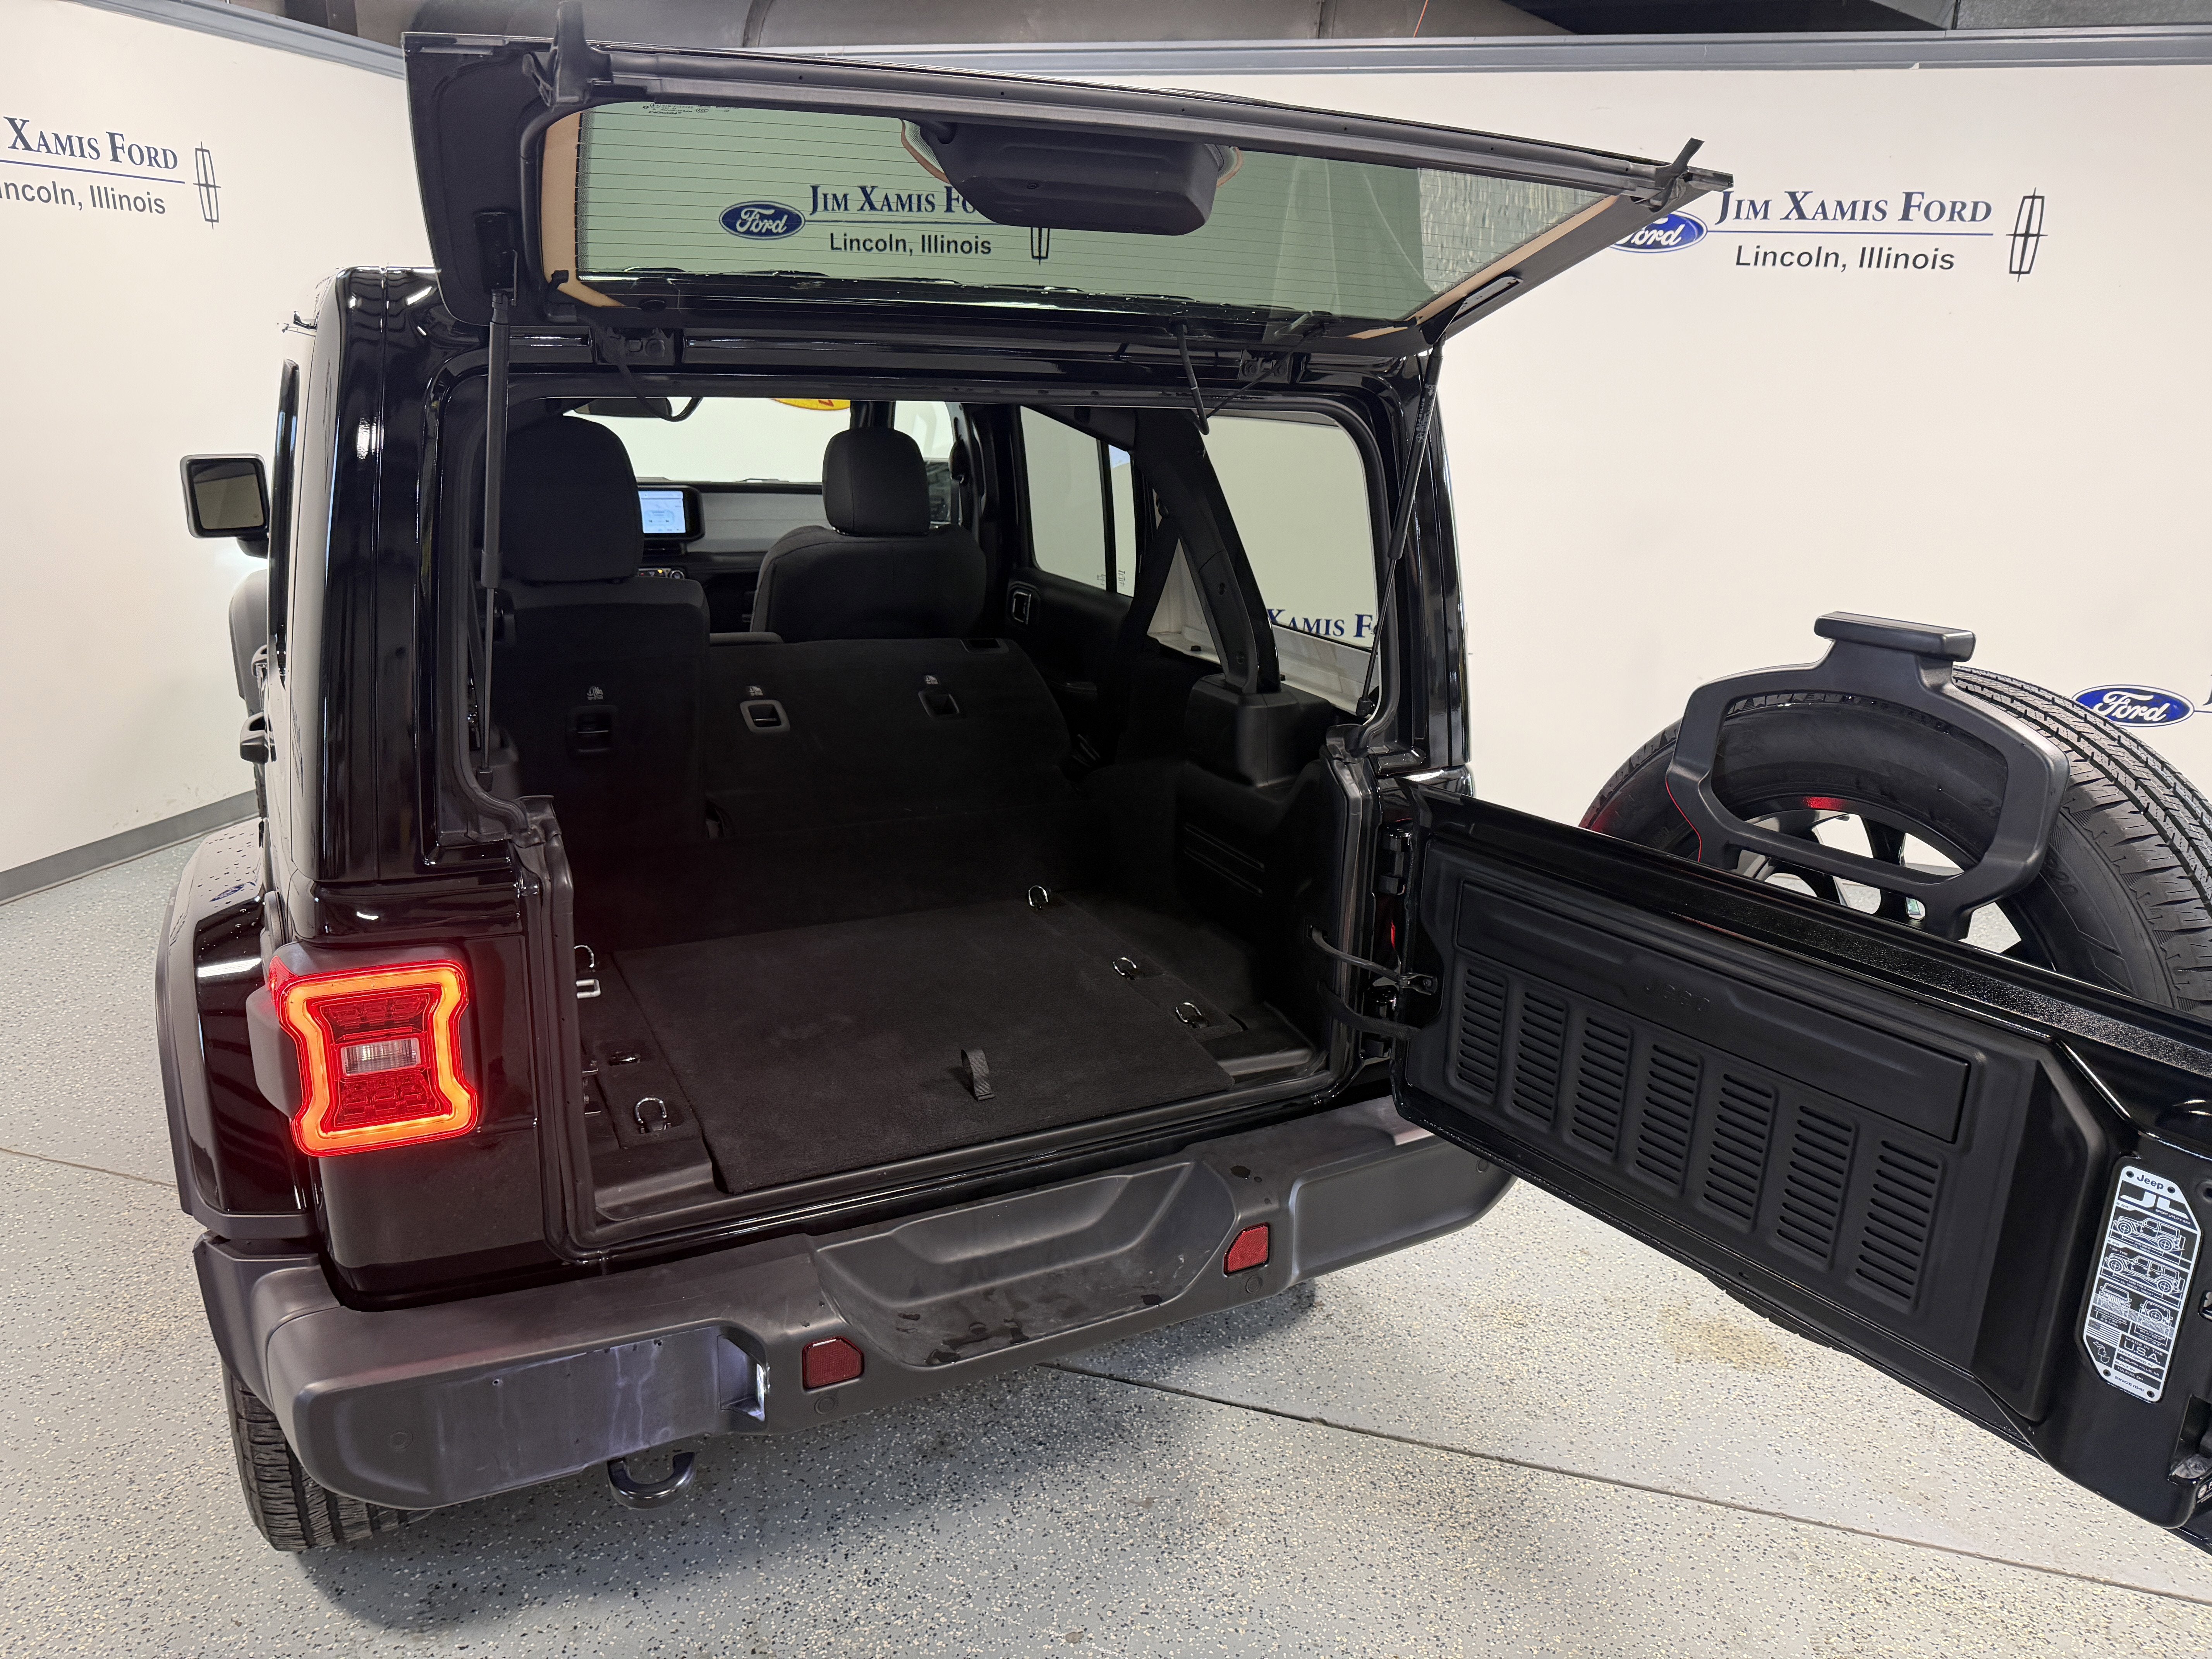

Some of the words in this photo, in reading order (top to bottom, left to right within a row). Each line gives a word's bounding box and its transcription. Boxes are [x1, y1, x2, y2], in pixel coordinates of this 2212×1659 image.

[3, 116, 100, 160] XAMIS
[106, 131, 178, 169] FORD
[0, 181, 82, 211] ncoln,
[90, 185, 166, 214] Illinois
[810, 185, 849, 215] JIM
[857, 186, 935, 213] XAMIS
[1715, 191, 1772, 225] JIM
[1780, 191, 1888, 222] XAMIS
[1898, 192, 1992, 222] FORD
[736, 208, 787, 233] Ford
[830, 233, 913, 256] Lincoln,
[922, 234, 991, 254] Illinois
[1736, 246, 1846, 272] Lincoln,
[1859, 247, 1955, 270] Illinois
[2093, 691, 2170, 721] Ford
[2136, 1175, 2164, 1190] Jeep
[2120, 1191, 2189, 1219] JL
[2123, 1340, 2162, 1364] U.S.A.
[2125, 1336, 2142, 1347] MADE
[2114, 1360, 2128, 1369] BUILT
[2117, 1348, 2147, 1364] DEVELOPED
[2119, 1355, 2139, 1367] AUBURN
[2114, 1376, 2132, 1386] SINCE
